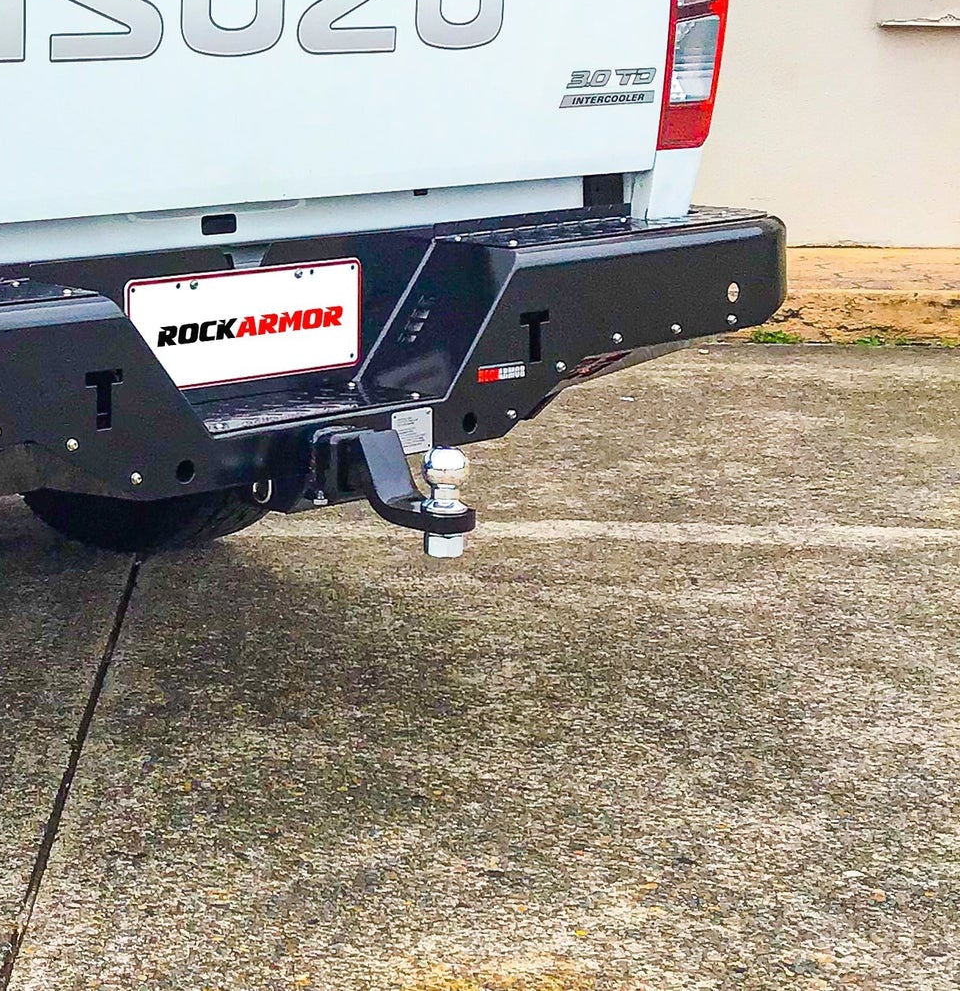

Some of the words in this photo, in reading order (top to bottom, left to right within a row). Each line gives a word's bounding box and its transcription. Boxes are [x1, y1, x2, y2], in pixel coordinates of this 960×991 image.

[566, 70, 611, 89] 3.0
[615, 67, 656, 86] TD
[572, 93, 645, 105] INTERCOOLER
[157, 305, 343, 347] ROCKARMOR
